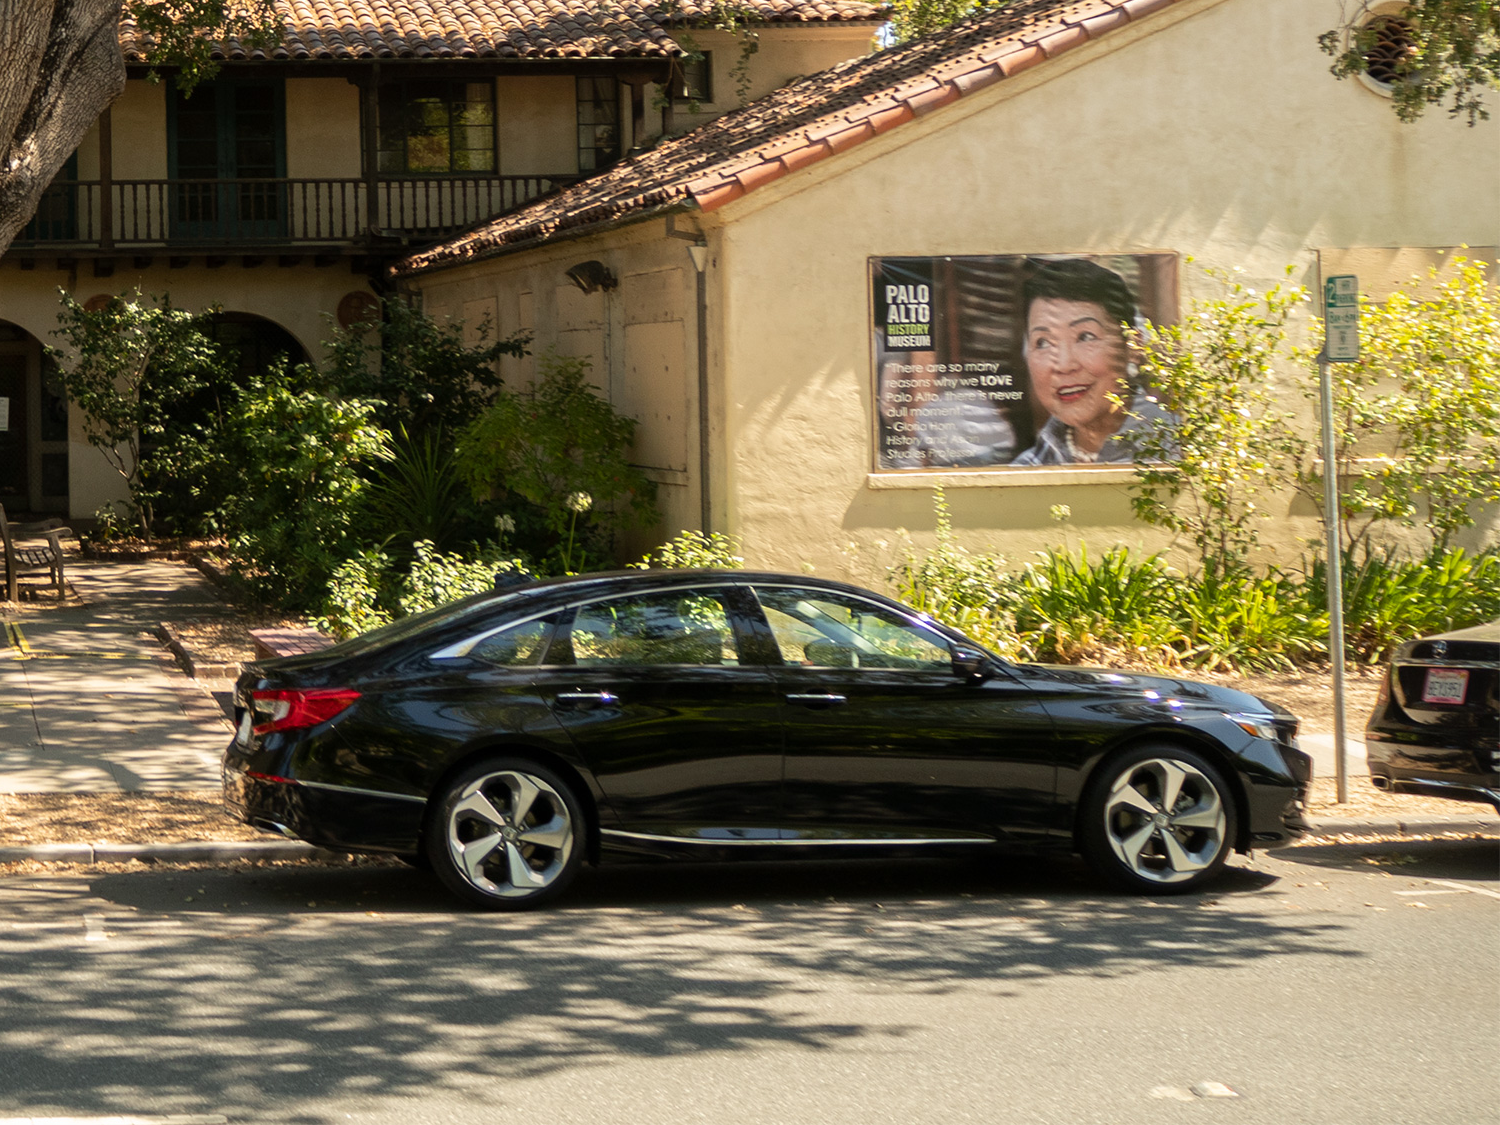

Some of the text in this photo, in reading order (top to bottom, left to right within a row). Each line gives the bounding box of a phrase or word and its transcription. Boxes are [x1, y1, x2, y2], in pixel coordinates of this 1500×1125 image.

[885, 284, 930, 304] PALO
[1327, 283, 1336, 303] 2
[886, 303, 931, 323] ALTO
[887, 323, 930, 335] HISTORY
[887, 335, 931, 347] MUSEUM
[925, 364, 947, 373] are
[948, 363, 963, 373] so
[964, 362, 1000, 373] many
[884, 375, 1013, 389] reasons why we LOVE
[885, 393, 913, 403] Palo
[944, 391, 977, 402] there
[978, 390, 987, 401] is
[988, 391, 1024, 401] never
[887, 407, 908, 418] dull
[893, 421, 927, 433] Gloria
[886, 435, 921, 446] History
[924, 435, 948, 445] and
[886, 448, 926, 459] Studies
